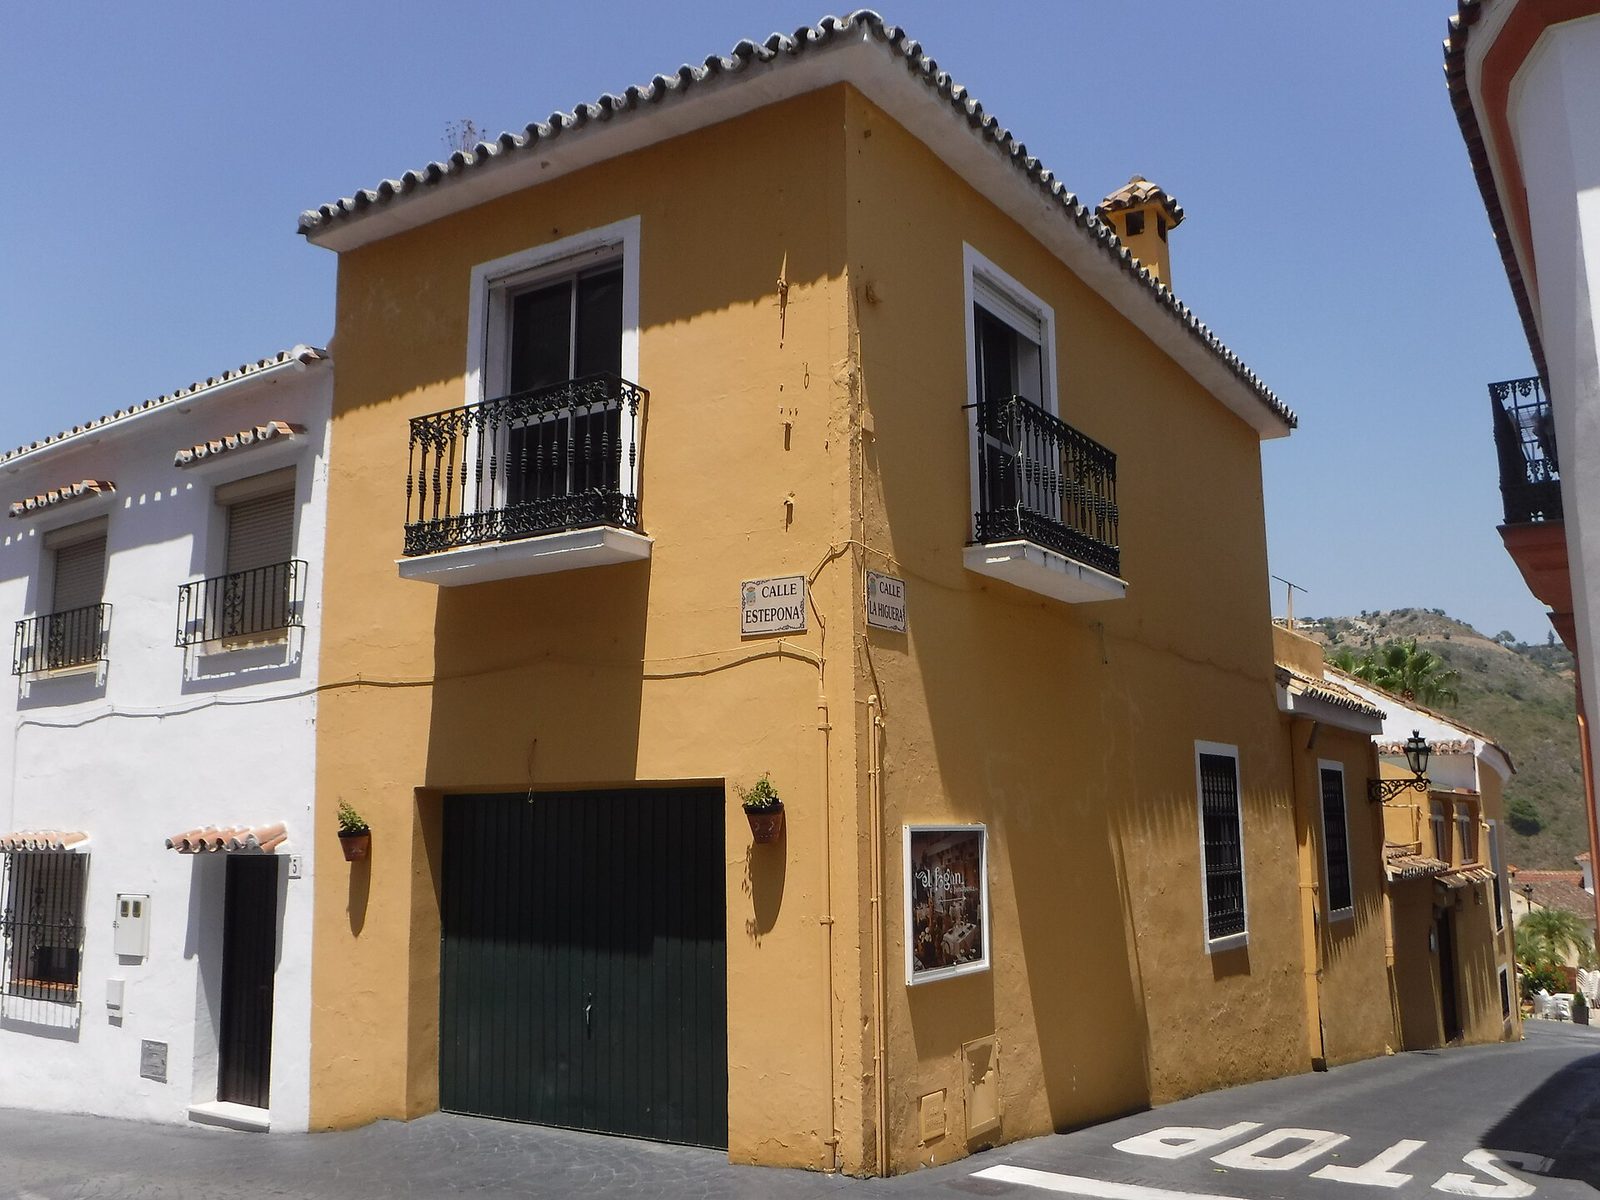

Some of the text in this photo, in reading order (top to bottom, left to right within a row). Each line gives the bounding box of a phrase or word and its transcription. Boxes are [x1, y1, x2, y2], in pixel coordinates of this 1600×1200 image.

[761, 583, 797, 598] CALLE
[879, 581, 901, 598] CALLE
[745, 606, 800, 624] ESTEPONA
[869, 600, 903, 622] LA HIGUERA
[1112, 1121, 1555, 1198] STOP
